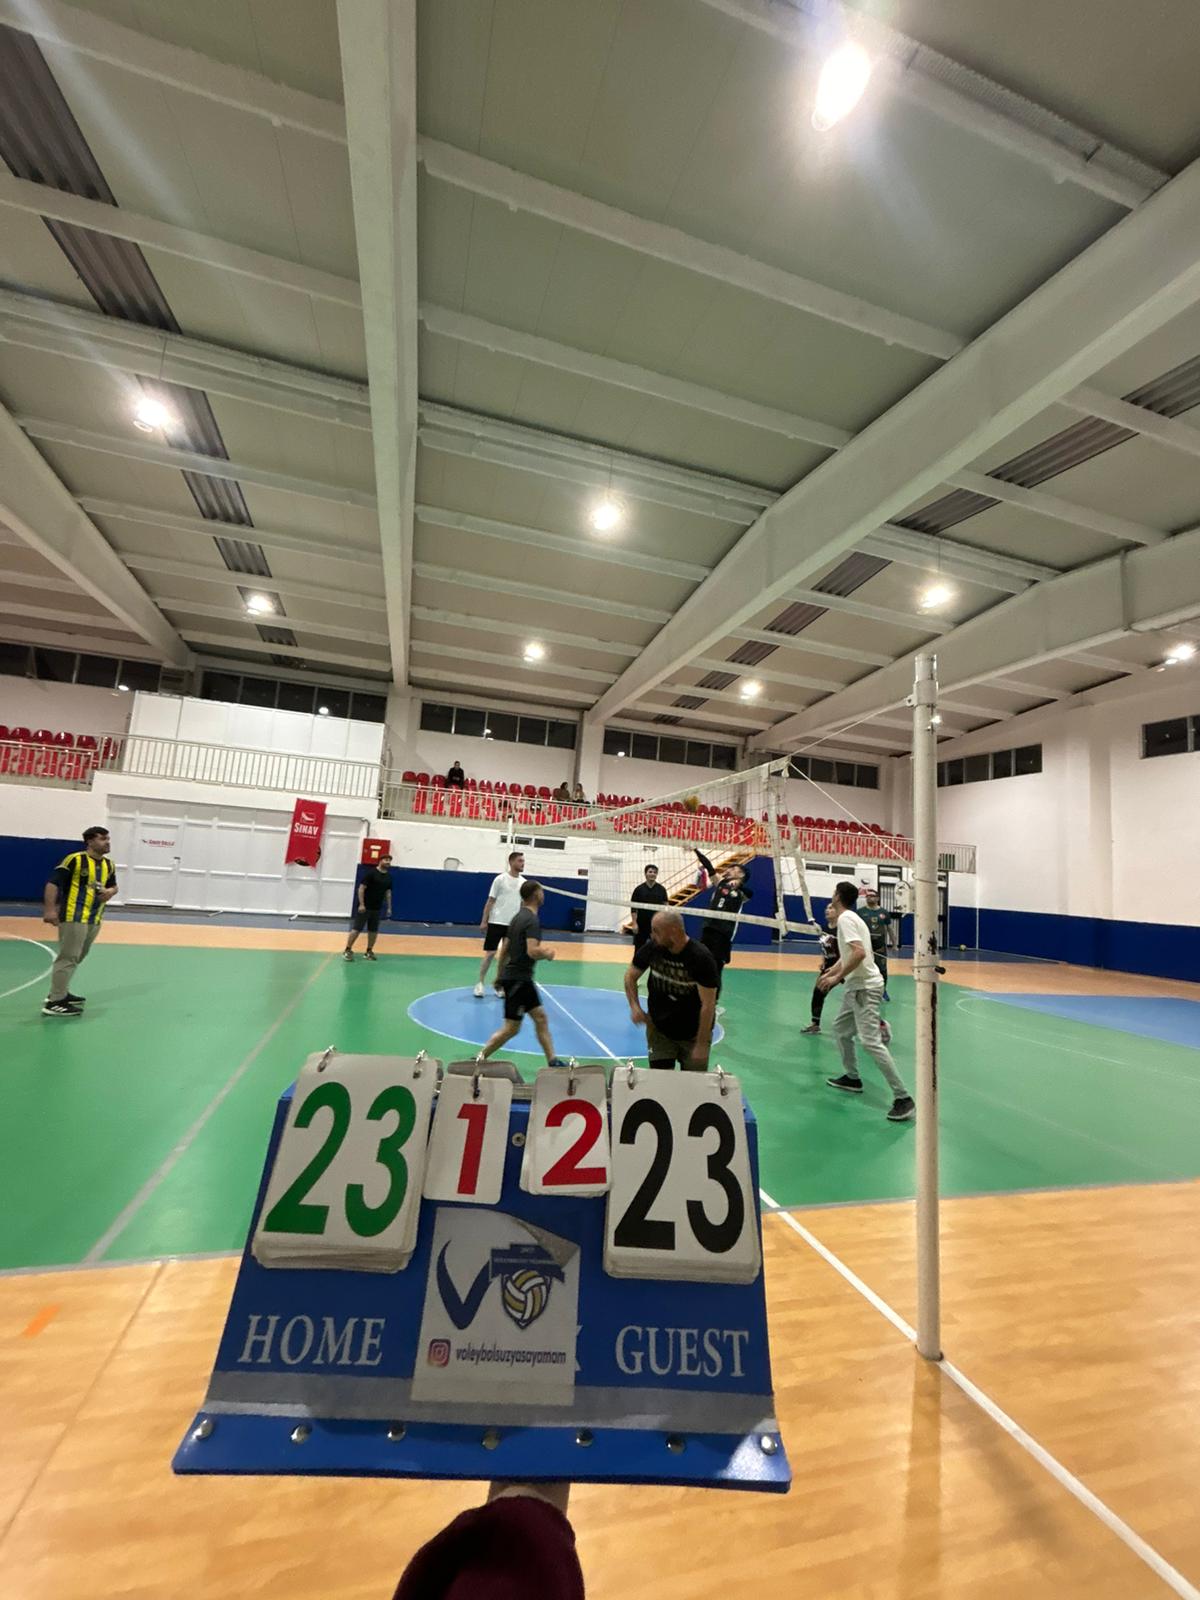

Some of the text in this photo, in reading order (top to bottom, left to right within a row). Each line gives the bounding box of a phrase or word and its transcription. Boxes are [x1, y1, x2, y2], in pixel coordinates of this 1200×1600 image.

[263, 1081, 417, 1238] 23
[457, 1103, 487, 1195] 1
[542, 1099, 608, 1187] 2
[614, 1098, 745, 1254] 23
[237, 1315, 385, 1366] HOME
[615, 1325, 749, 1377] GUEST
[456, 1341, 566, 1367] voleybolsuzyasayamam
